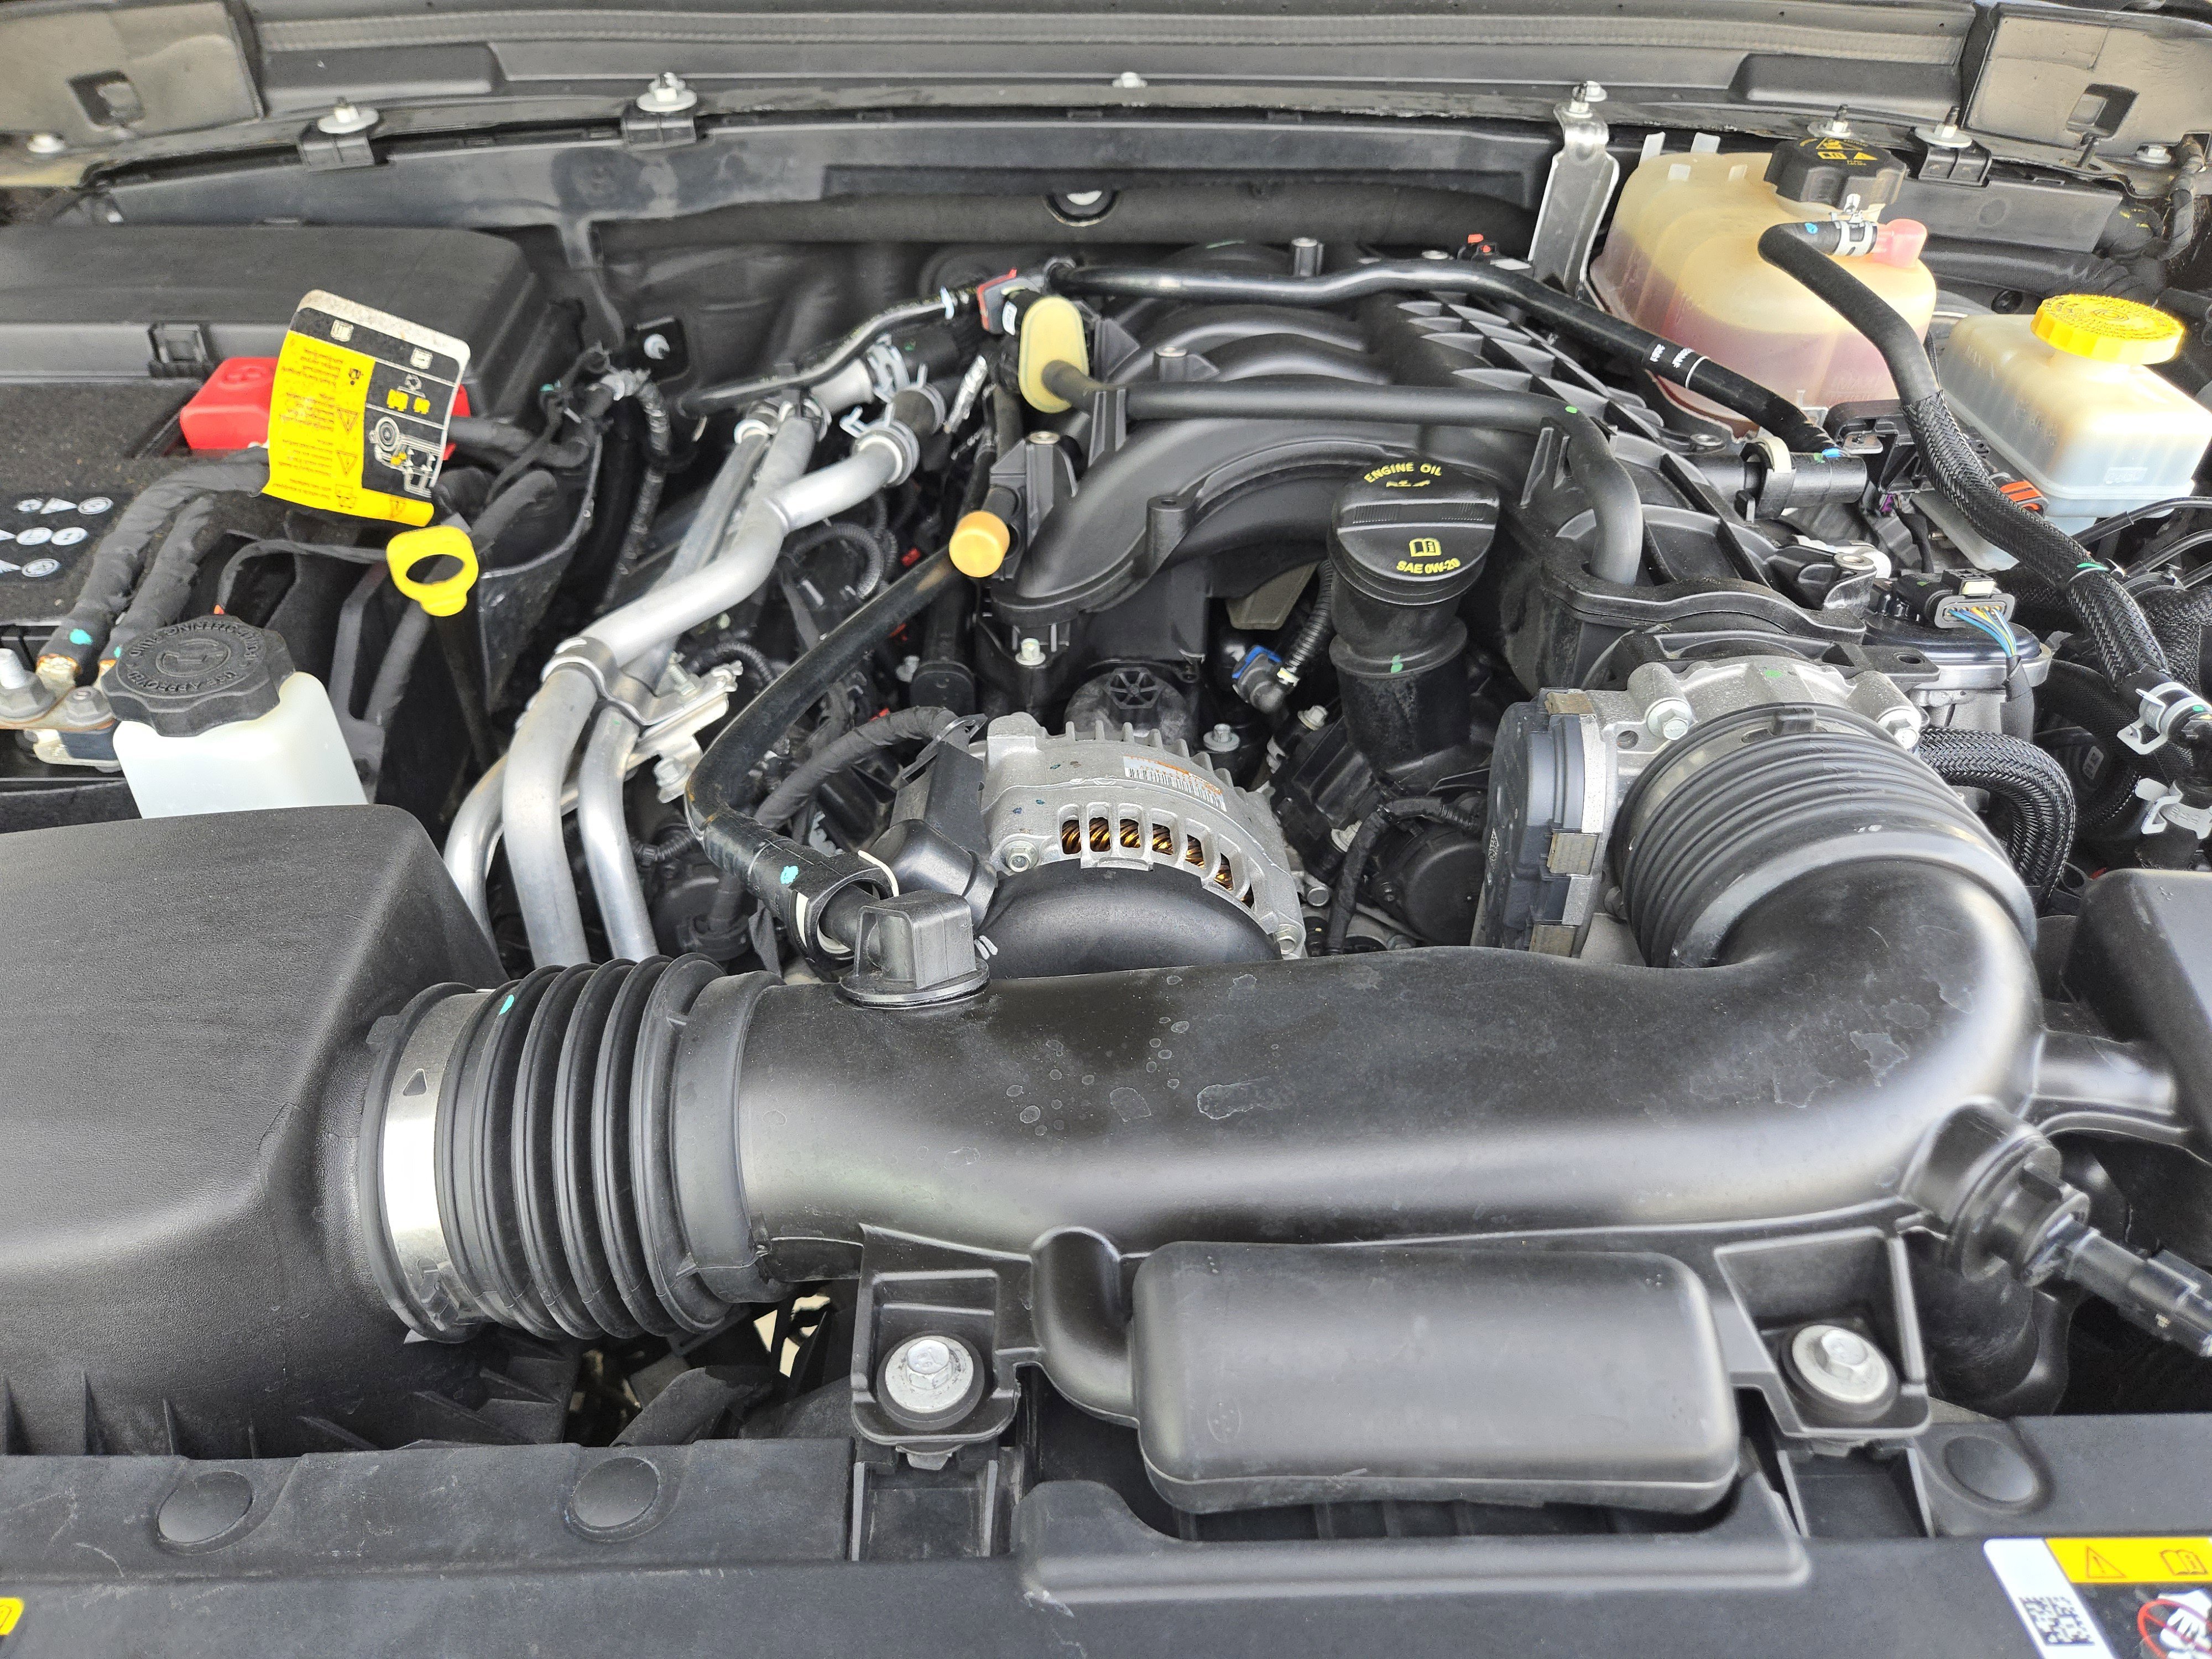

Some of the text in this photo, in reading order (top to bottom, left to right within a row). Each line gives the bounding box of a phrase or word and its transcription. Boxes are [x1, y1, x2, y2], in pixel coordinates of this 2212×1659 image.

[1364, 462, 1442, 483] ENGINE OIL
[1396, 557, 1461, 574] SAE 0W-20
[164, 621, 238, 636] STEERING
[129, 633, 163, 657] FLUID
[127, 671, 237, 692] USE APPROVED
